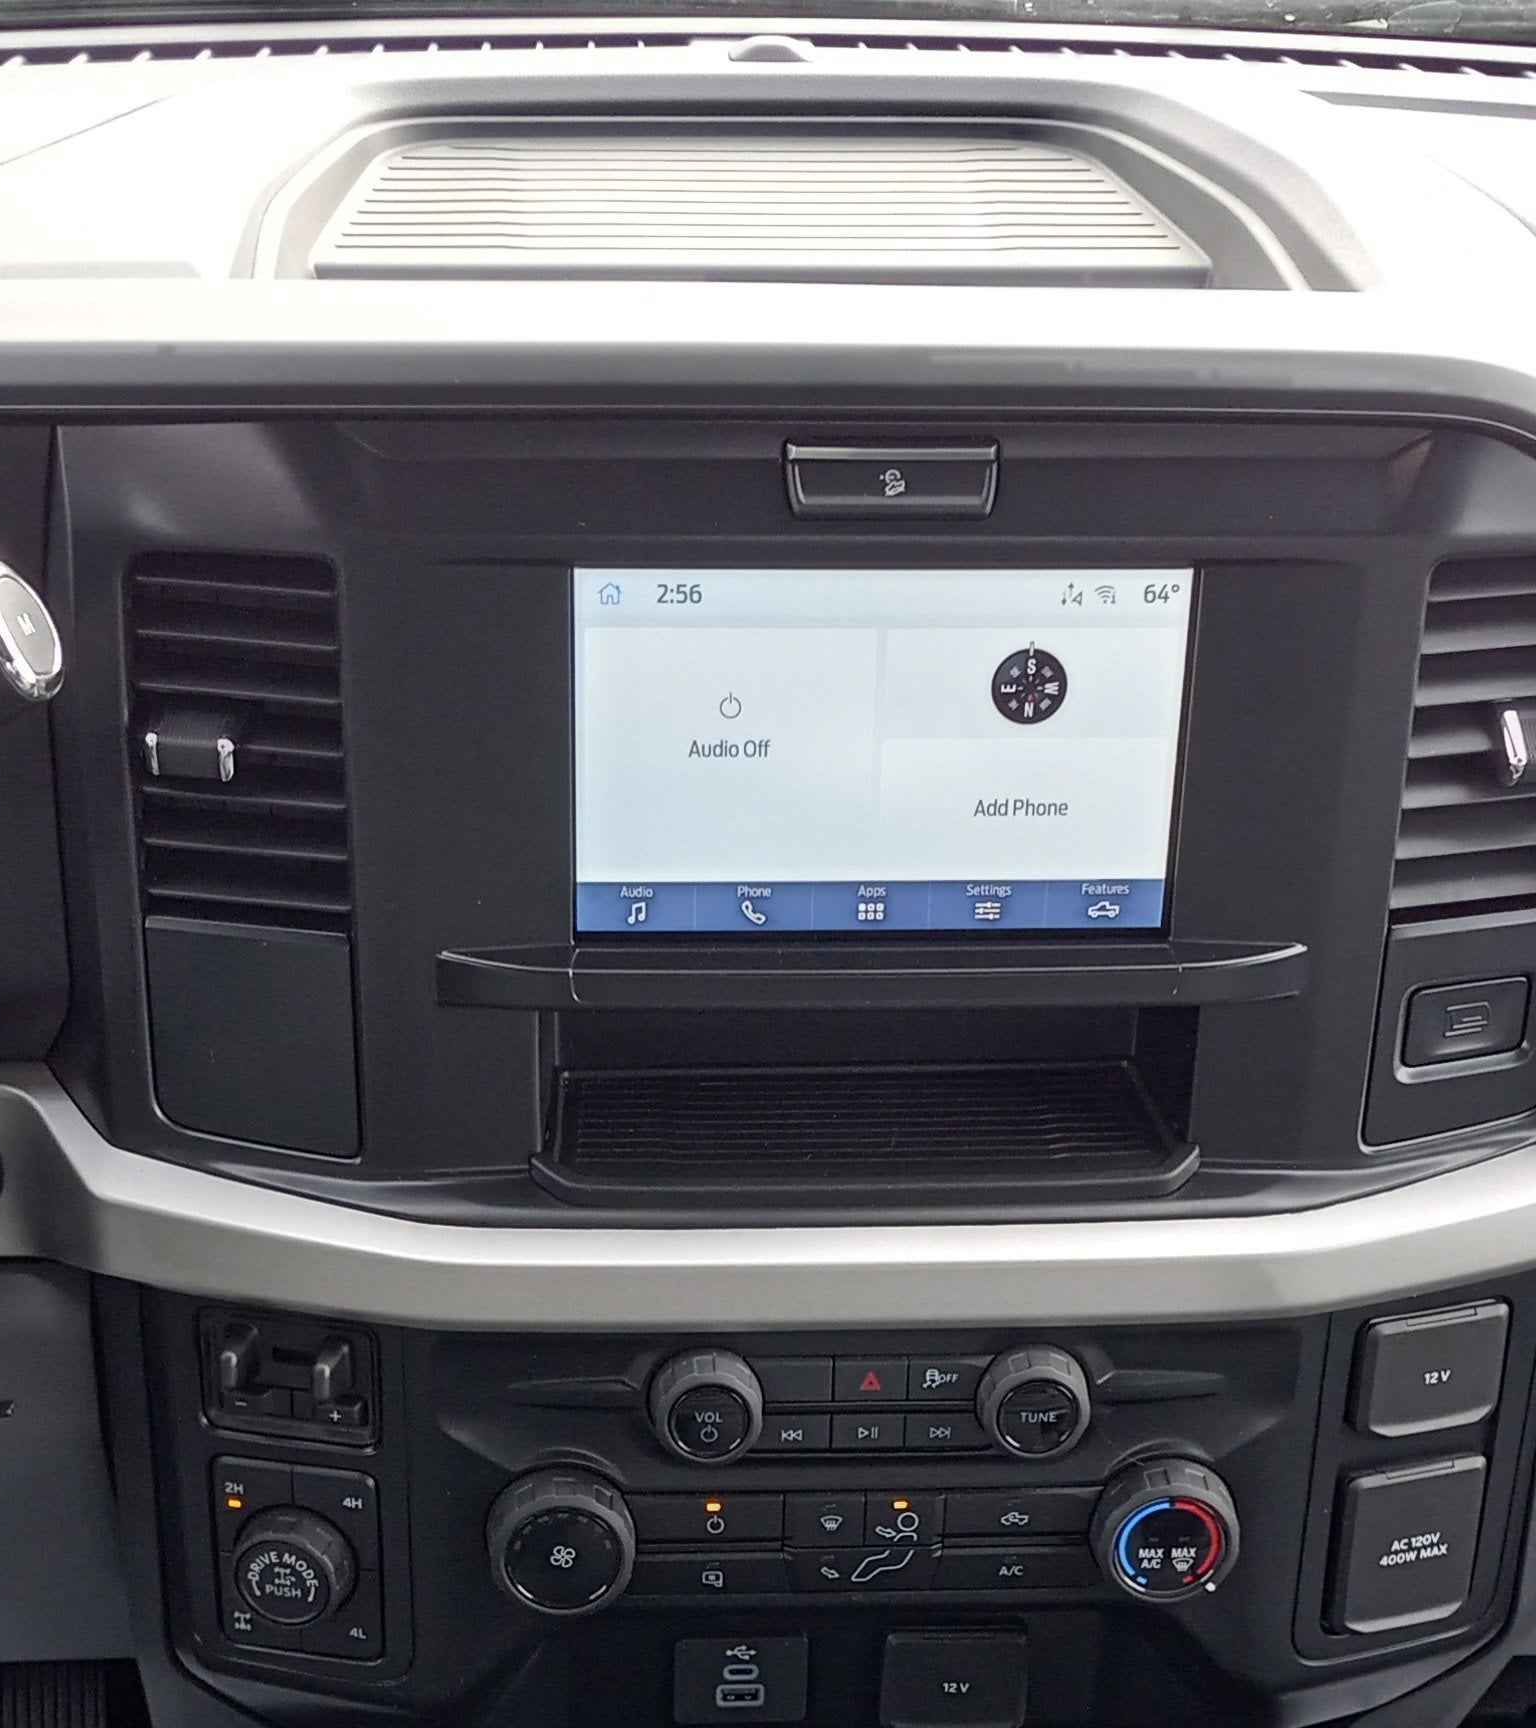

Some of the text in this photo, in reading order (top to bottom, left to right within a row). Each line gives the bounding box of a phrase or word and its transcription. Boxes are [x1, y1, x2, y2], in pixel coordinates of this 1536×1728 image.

[656, 582, 703, 605] 2:56
[1143, 583, 1181, 604] 64°
[1027, 658, 1037, 675] S
[1024, 701, 1034, 718] N
[688, 738, 771, 759] Audio Off
[973, 797, 1069, 818] Add Phone
[619, 885, 654, 899] Audio
[736, 885, 772, 899] Phone
[857, 885, 887, 901] Apps
[966, 884, 1012, 900] Settings
[1081, 882, 1130, 897] Features
[938, 1374, 958, 1382] OFF
[1424, 1369, 1451, 1385] 12 V
[695, 1411, 723, 1424] VOL
[1020, 1411, 1058, 1423] TUNE
[224, 1482, 244, 1495] 2H
[342, 1497, 363, 1510] 4H
[1390, 1531, 1441, 1552] AC 120V
[1138, 1547, 1164, 1559] MAX
[1171, 1547, 1197, 1558] MAX
[1379, 1542, 1449, 1567] 400W MAX
[247, 1550, 319, 1587] DRIVE MODE
[1140, 1558, 1161, 1569] A/C
[999, 1565, 1024, 1577] A/C
[265, 1584, 302, 1598] PUSH
[349, 1627, 367, 1639] 4L
[942, 1682, 970, 1694] 12 V
